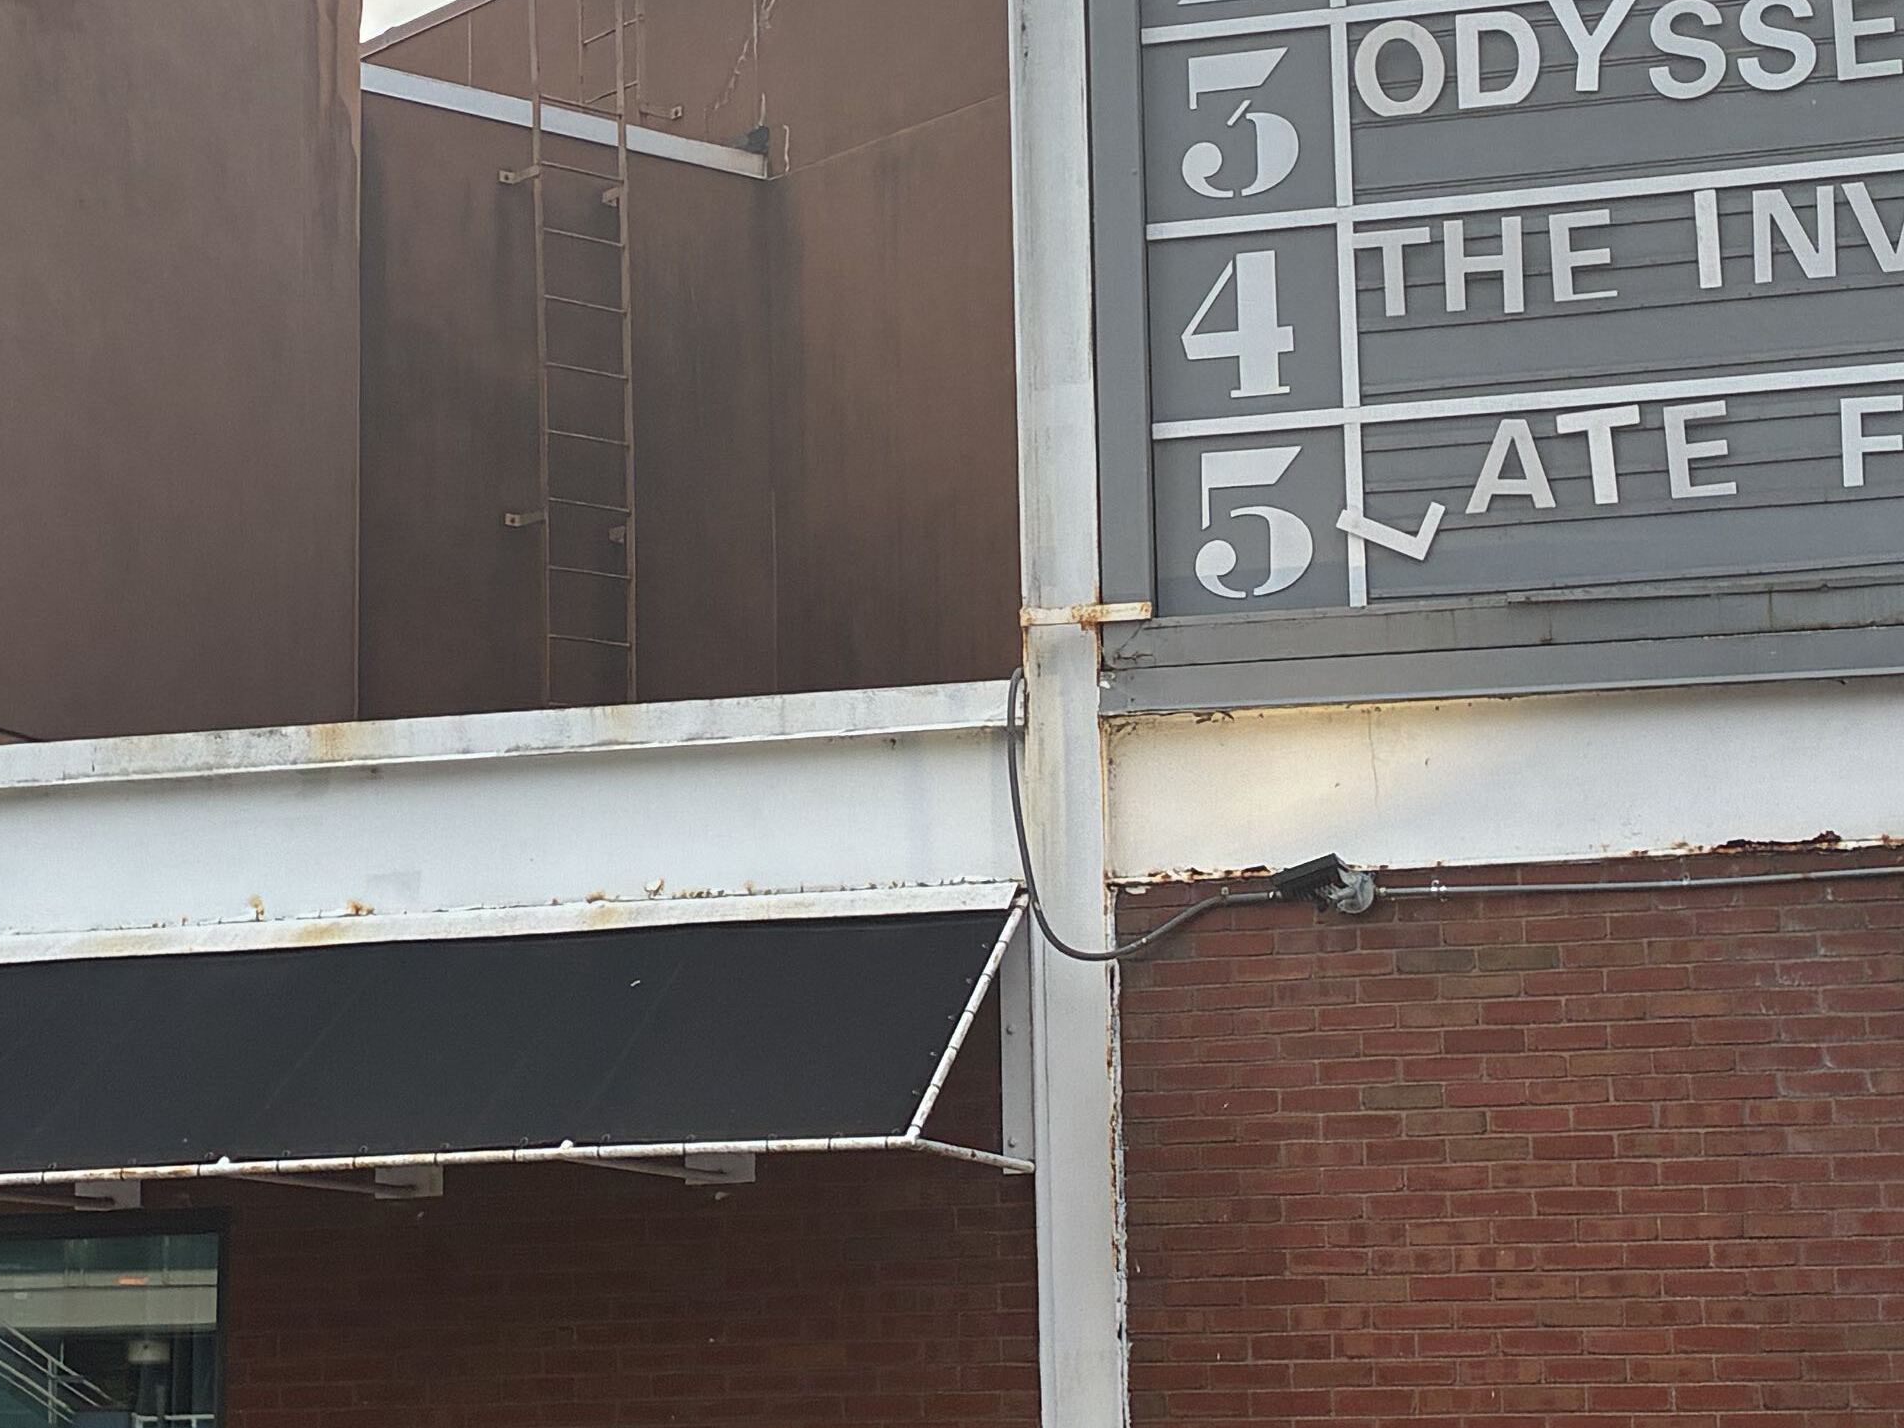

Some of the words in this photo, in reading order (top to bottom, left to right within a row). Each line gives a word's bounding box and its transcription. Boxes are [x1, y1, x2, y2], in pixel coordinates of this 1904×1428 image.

[1180, 46, 1300, 199] 3
[1180, 248, 1295, 399] 4
[1351, 207, 1620, 318] THE
[1194, 444, 1315, 599] 5
